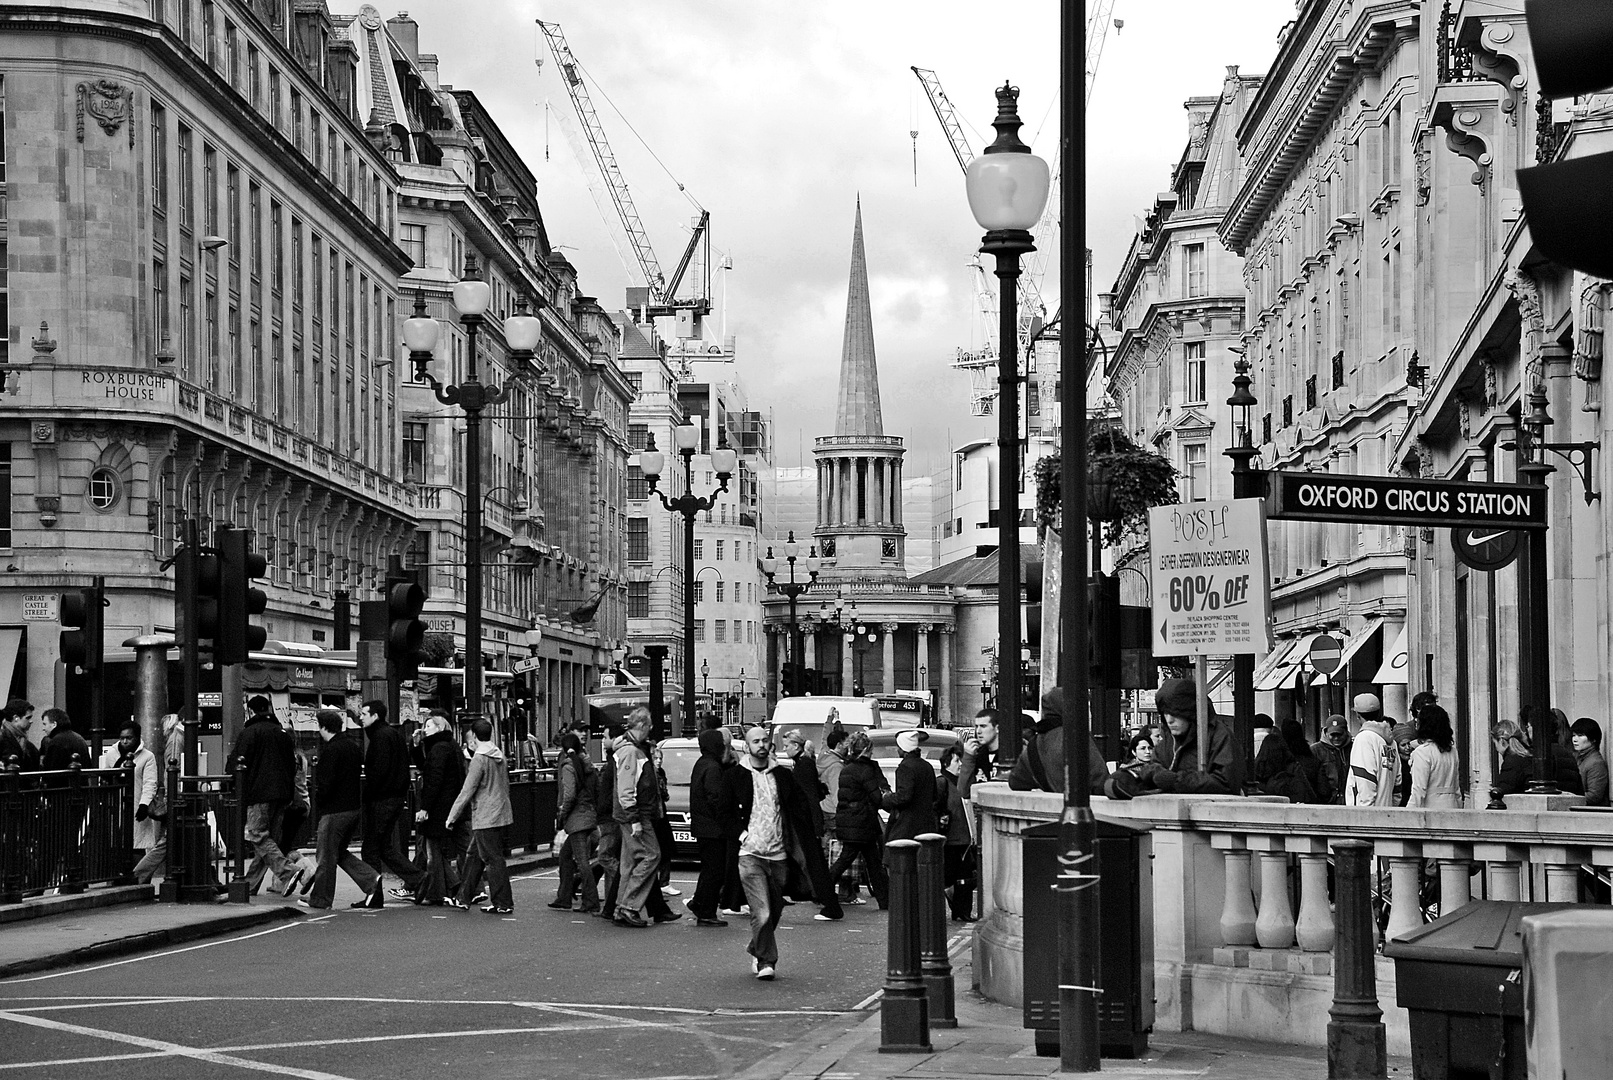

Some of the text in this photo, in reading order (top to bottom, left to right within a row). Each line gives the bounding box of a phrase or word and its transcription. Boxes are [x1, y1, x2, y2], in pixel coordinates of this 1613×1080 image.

[82, 371, 166, 389] ROXBURGHE
[106, 386, 154, 401] HOUSE
[1298, 484, 1531, 516] OXFORD CIRCUS STATION
[1170, 505, 1229, 546] POSH
[1202, 549, 1250, 567] DESIGNERWEAR
[1170, 575, 1250, 612] 60% OFF
[902, 701, 916, 710] 453
